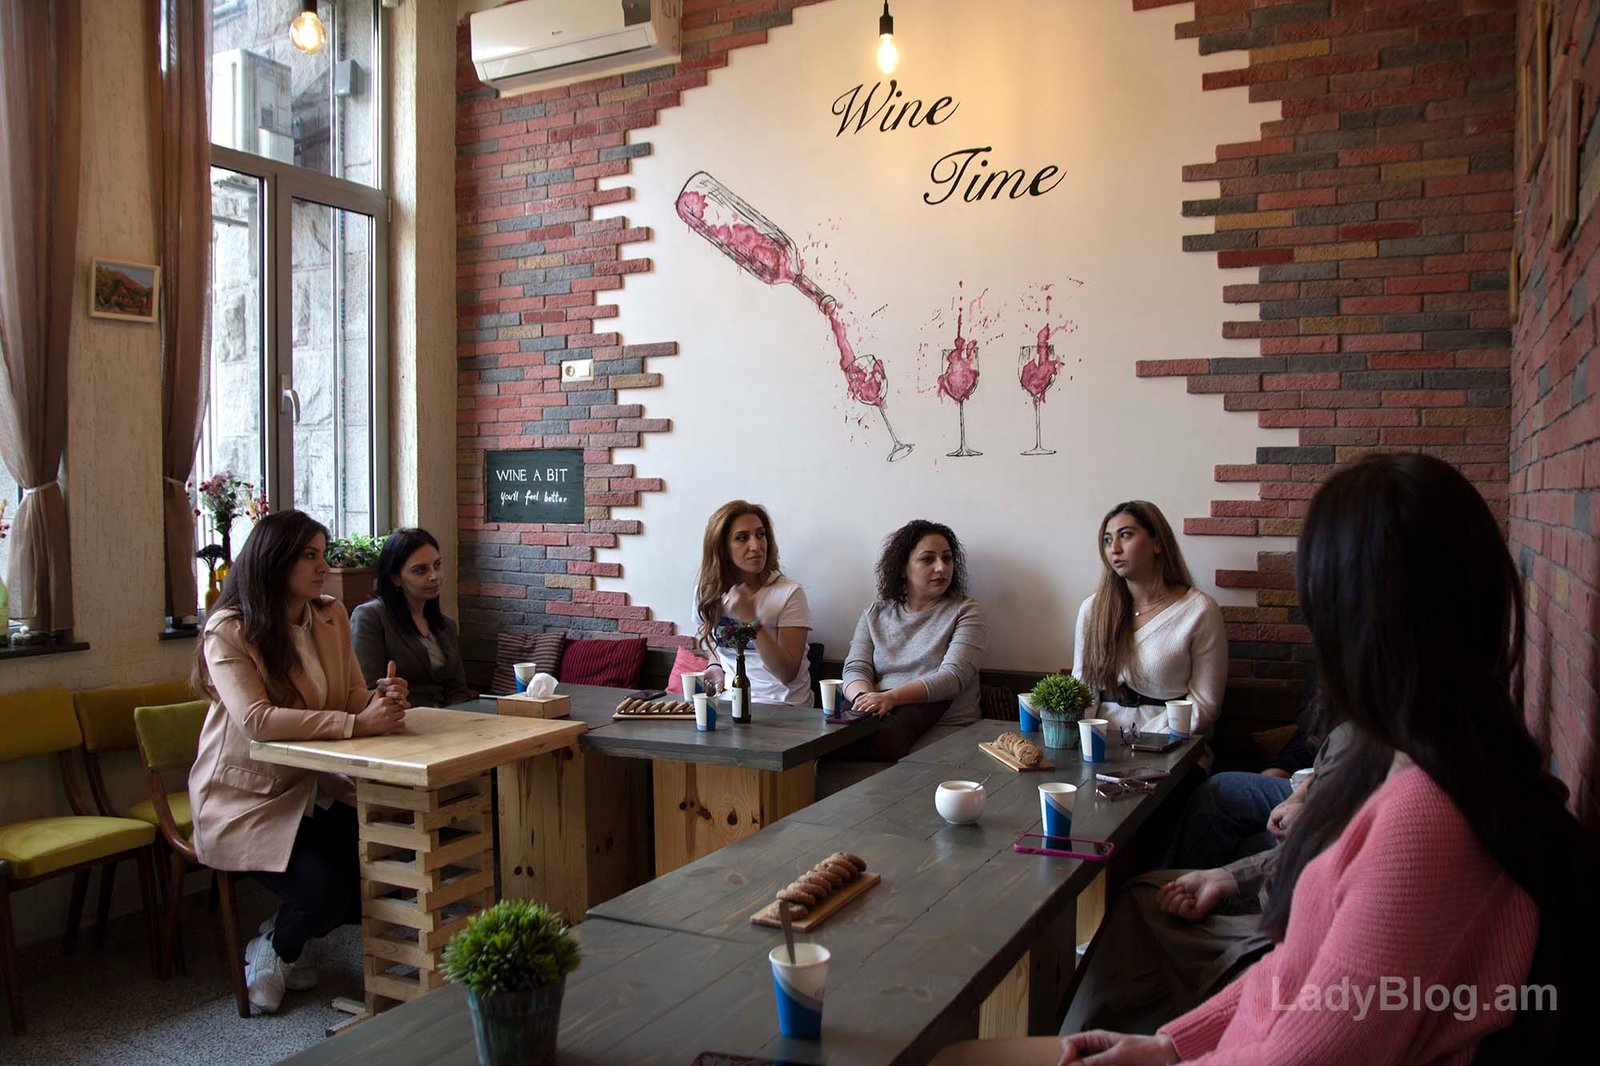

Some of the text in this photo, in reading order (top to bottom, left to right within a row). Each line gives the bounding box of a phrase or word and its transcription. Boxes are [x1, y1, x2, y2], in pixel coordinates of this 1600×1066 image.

[831, 79, 960, 138] Wine
[923, 146, 1068, 205] Time
[496, 468, 568, 482] WINE A BIT
[525, 490, 539, 505] feel
[544, 491, 567, 503] better
